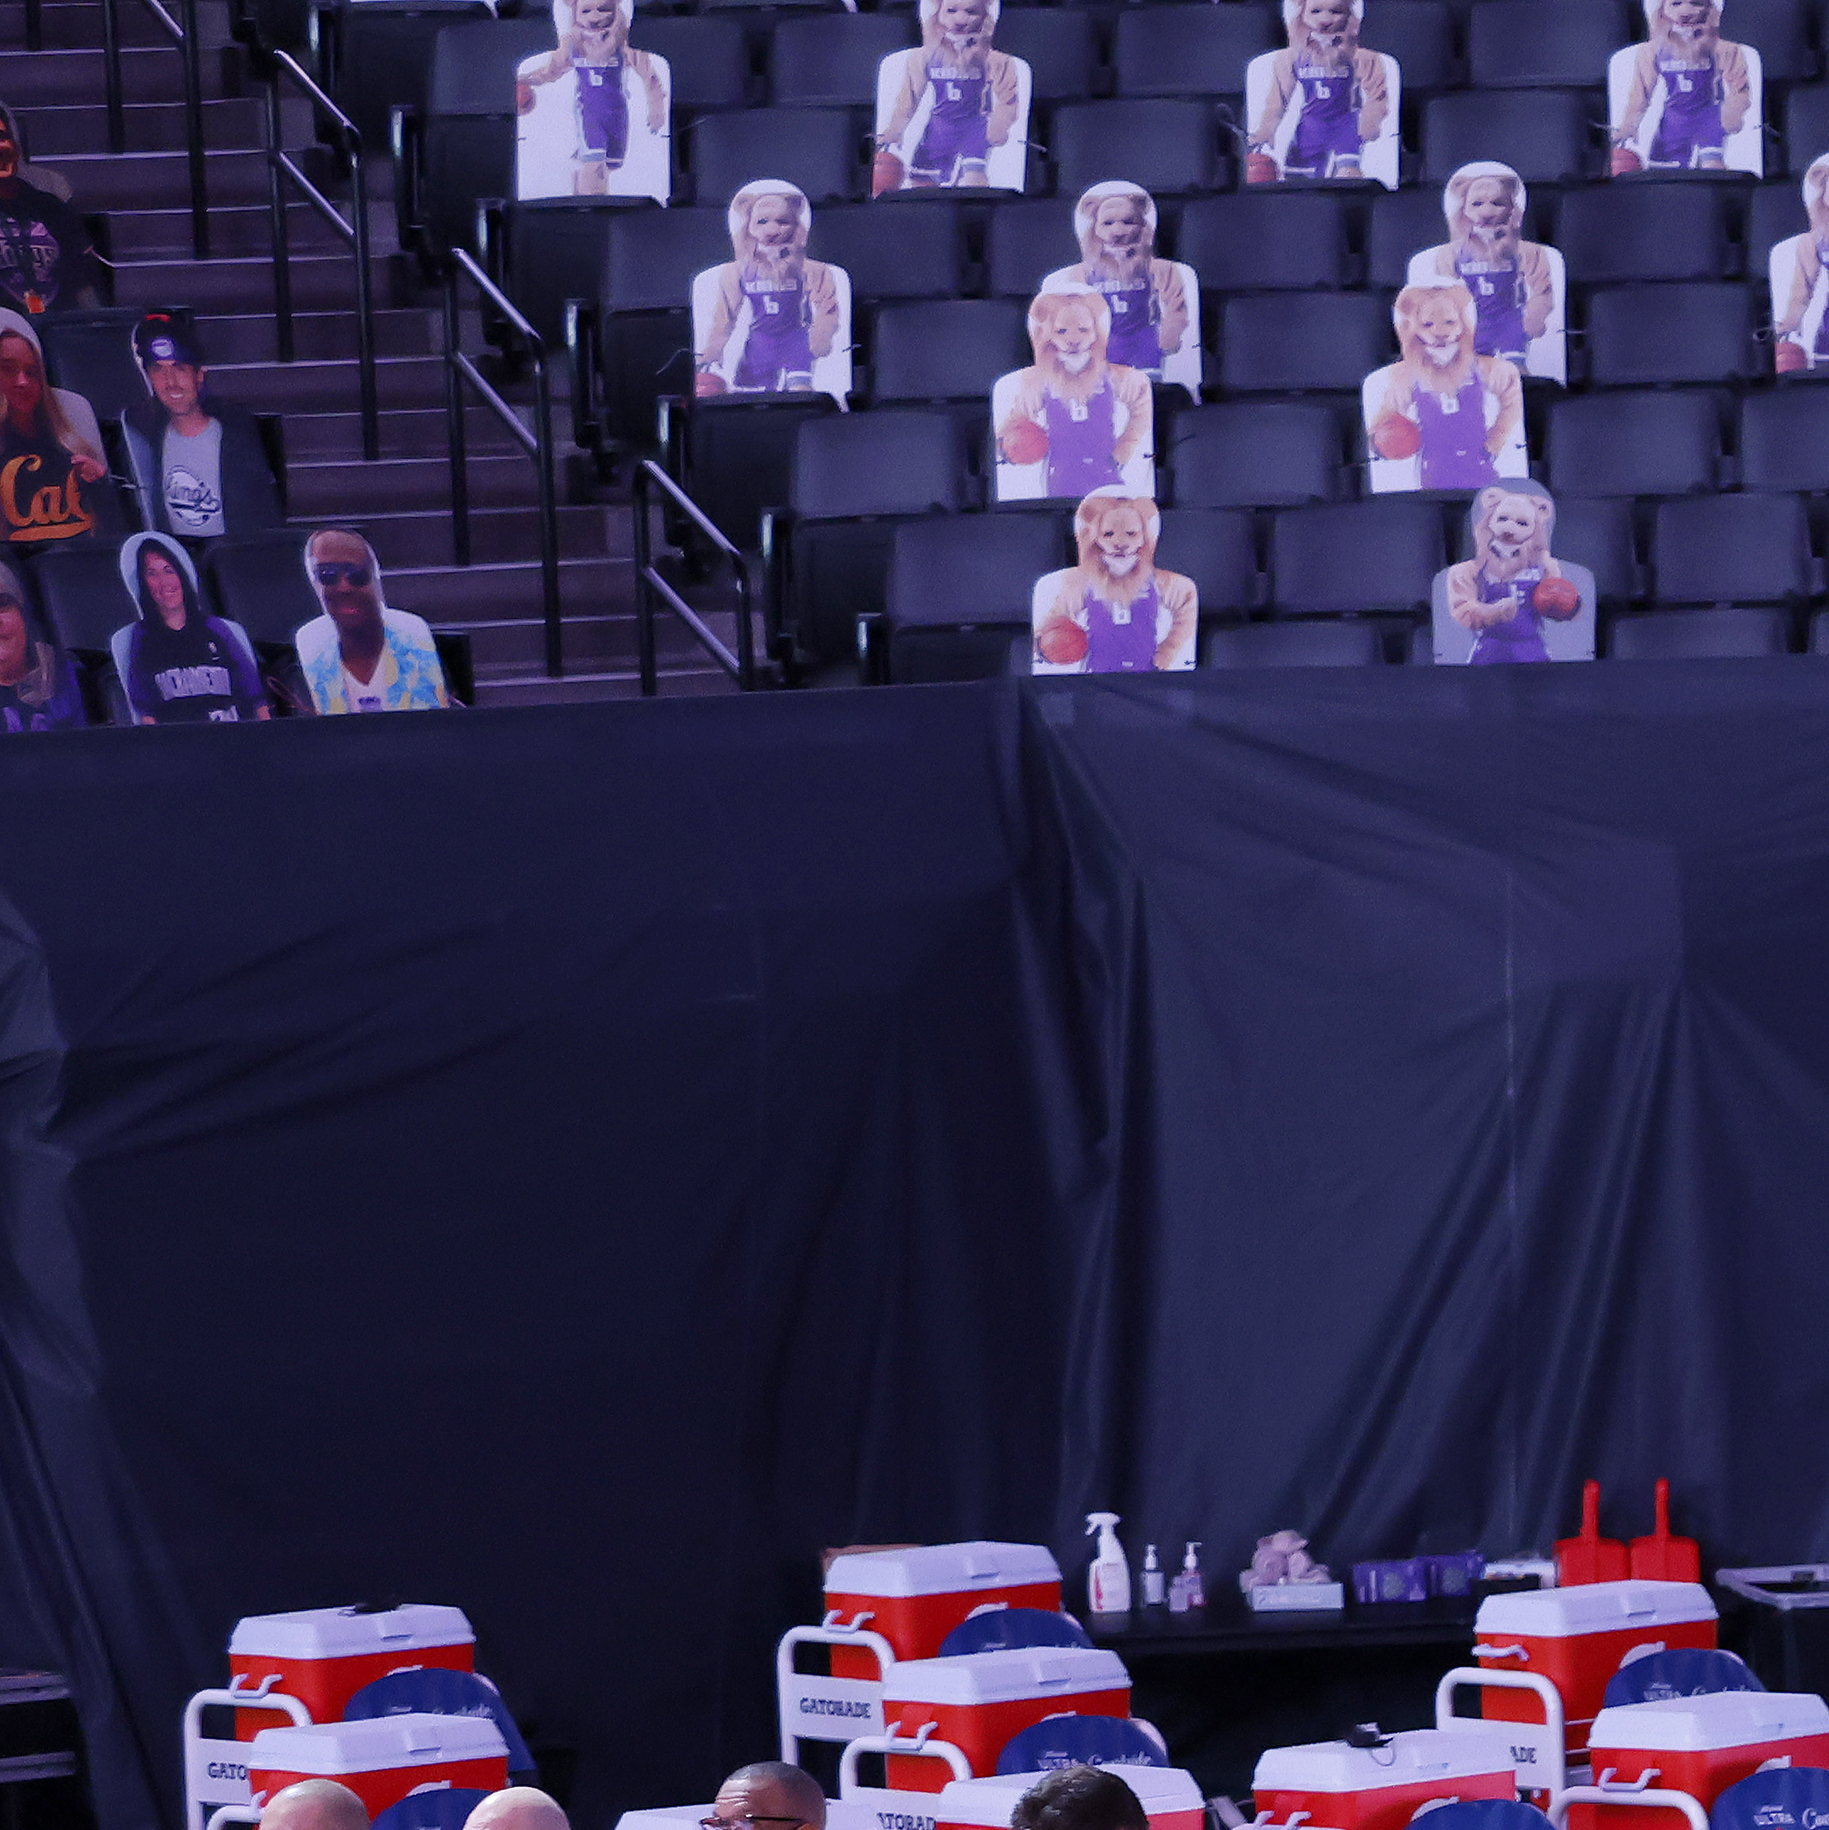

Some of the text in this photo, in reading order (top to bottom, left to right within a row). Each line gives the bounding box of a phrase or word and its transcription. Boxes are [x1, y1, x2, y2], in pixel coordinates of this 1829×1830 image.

[1, 454, 92, 532] Cal
[799, 1697, 872, 1720] GATORADE
[207, 1761, 249, 1781] GATO
